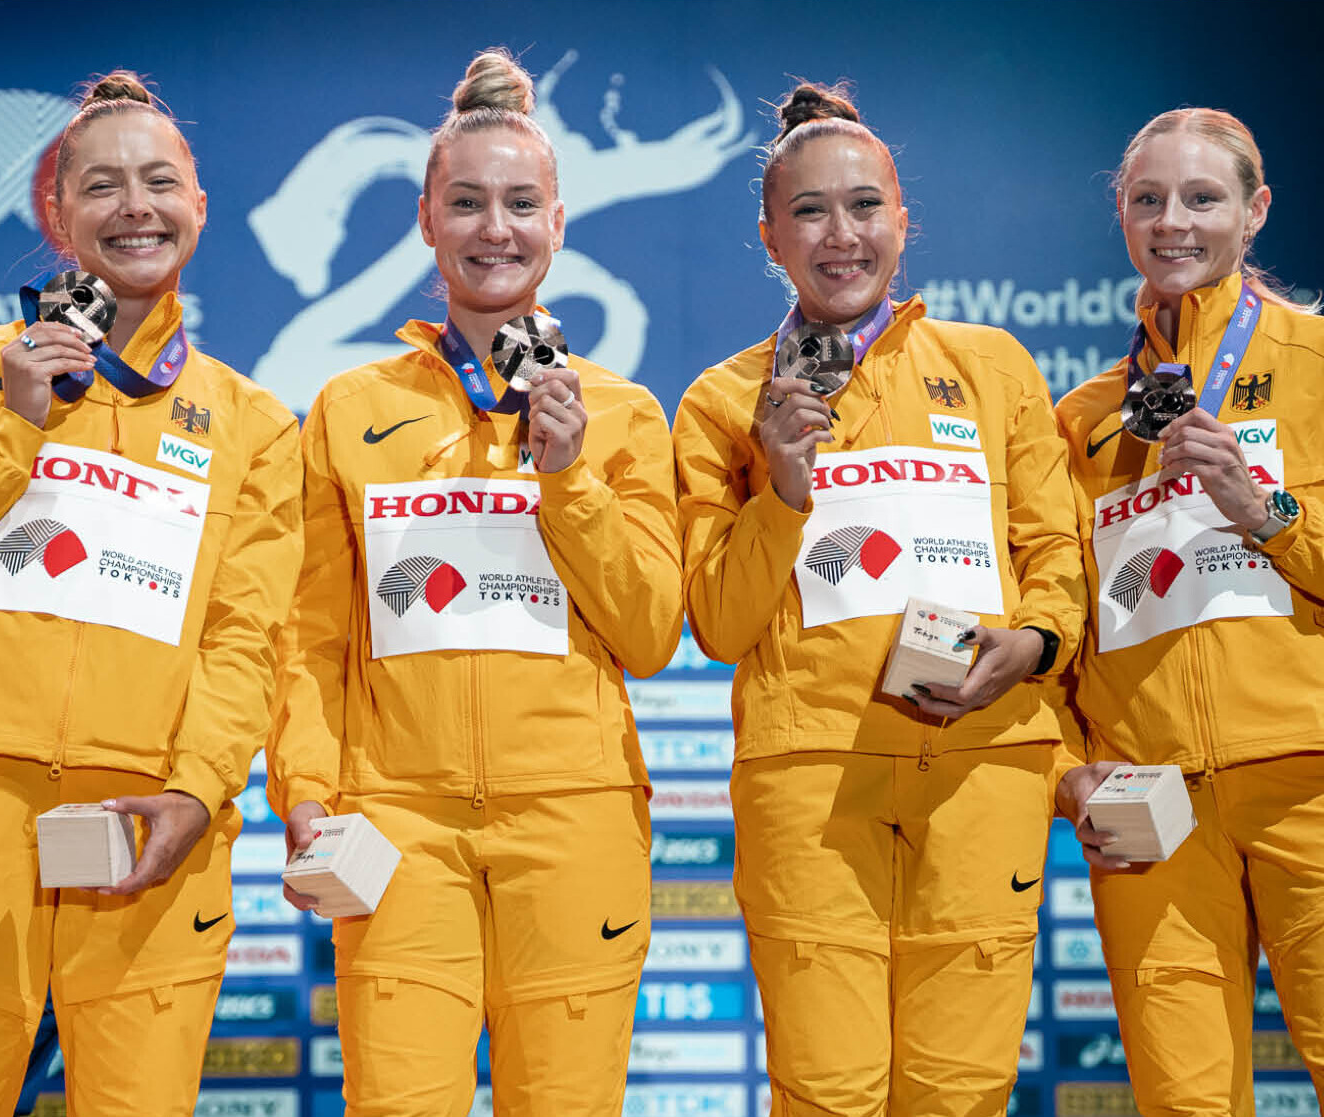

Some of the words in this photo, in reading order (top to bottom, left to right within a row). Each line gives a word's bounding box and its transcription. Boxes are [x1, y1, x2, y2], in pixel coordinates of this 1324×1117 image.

[931, 421, 977, 441] WGV
[161, 439, 209, 469] WGV
[811, 458, 986, 491] HONDA
[1099, 464, 1279, 529] HONA
[913, 536, 945, 546] WORLD
[946, 538, 989, 551] ATHLETICS
[914, 545, 990, 559] CHAMPIONSHIPS
[1194, 545, 1227, 557] WORLD
[99, 557, 182, 590] CHAMPIONSHIPS
[101, 548, 135, 564] WORLD
[136, 558, 183, 582] ATHLETICS
[478, 582, 560, 597] CHAMPIONSHIPS
[479, 573, 513, 582] WORLD
[514, 574, 560, 587] ATHLETICS
